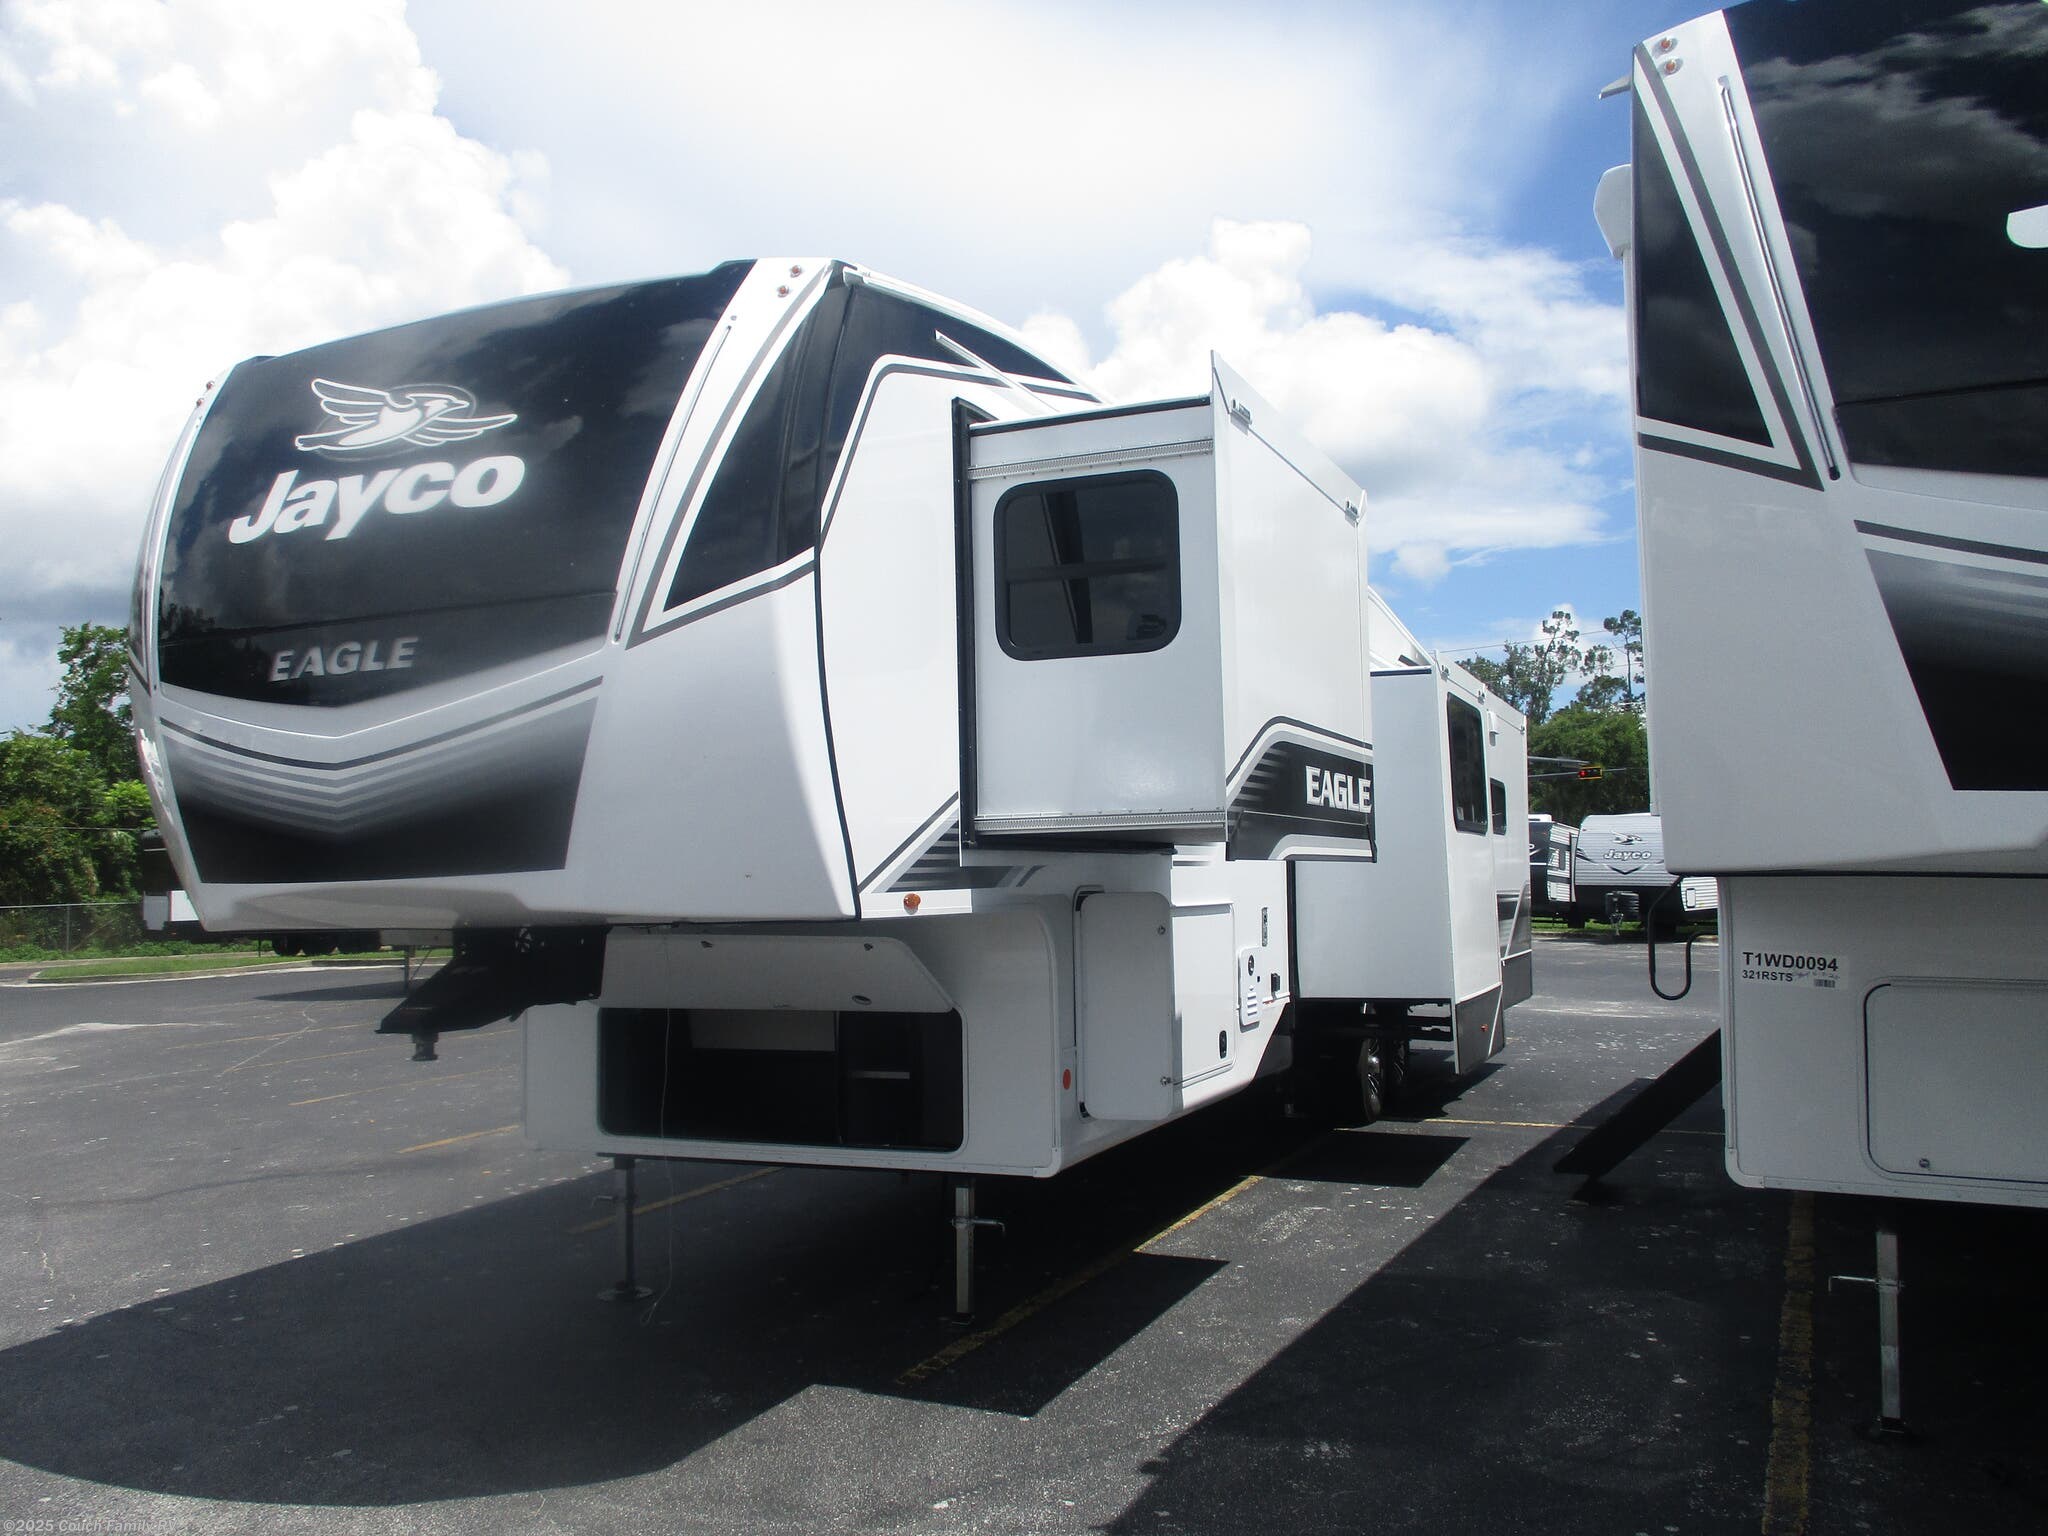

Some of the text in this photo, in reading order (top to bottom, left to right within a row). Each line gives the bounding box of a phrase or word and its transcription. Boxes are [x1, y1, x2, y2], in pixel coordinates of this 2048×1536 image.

[228, 455, 526, 544] Jayco
[271, 638, 419, 681] EAGLE
[1306, 766, 1372, 813] EAGLE
[1602, 848, 1652, 861] Jayco
[1742, 952, 1838, 971] T1WD0094
[1742, 969, 1793, 982] 321RSTS
